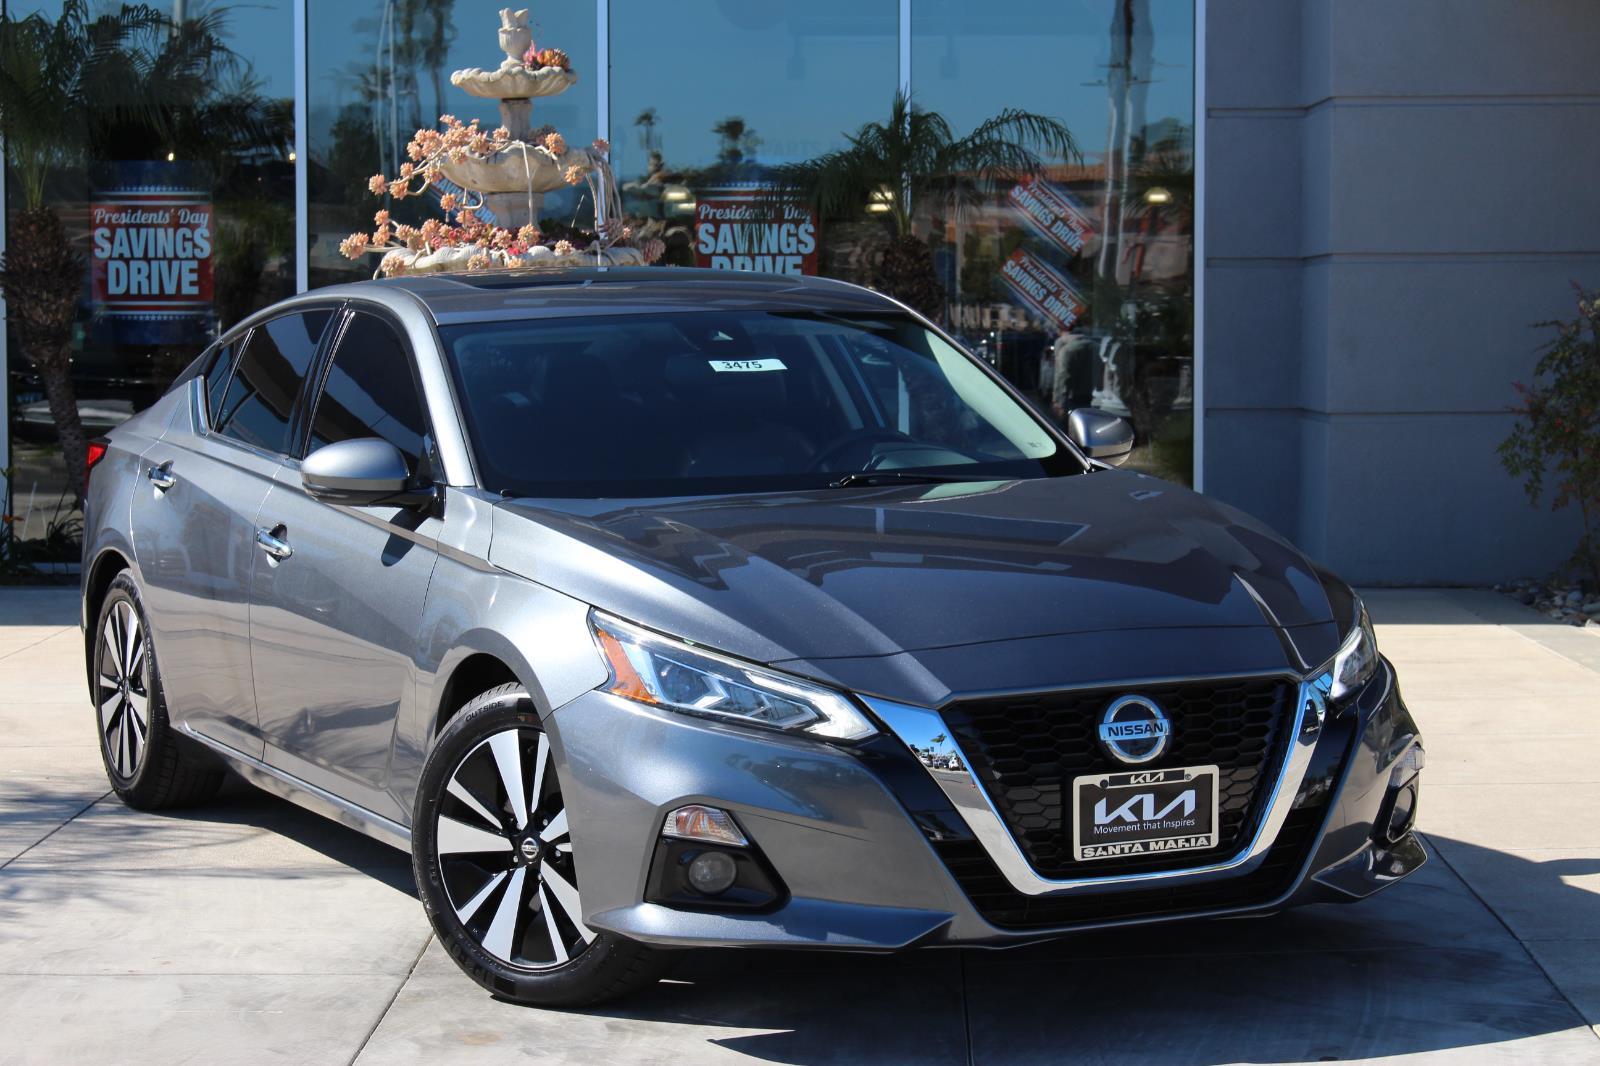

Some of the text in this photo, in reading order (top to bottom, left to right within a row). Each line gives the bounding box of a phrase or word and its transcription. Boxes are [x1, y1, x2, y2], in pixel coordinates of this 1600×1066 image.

[94, 208, 209, 227] Presidents' Day
[1011, 185, 1085, 252] SAVINGS DRIVE
[94, 227, 211, 259] SAVINGS
[698, 222, 816, 255] SAVINGS
[108, 260, 199, 295] DRIVE
[1003, 259, 1077, 327] SAVINGS DRIVE
[722, 361, 763, 369] 3475
[465, 701, 505, 721] OUTSIDE
[1108, 723, 1163, 737] NISSAN
[1130, 772, 1165, 784] KIA
[1094, 789, 1196, 825] KIA
[1093, 818, 1196, 835] Movement that Inspires
[1082, 836, 1209, 858] SANTA MARIA
